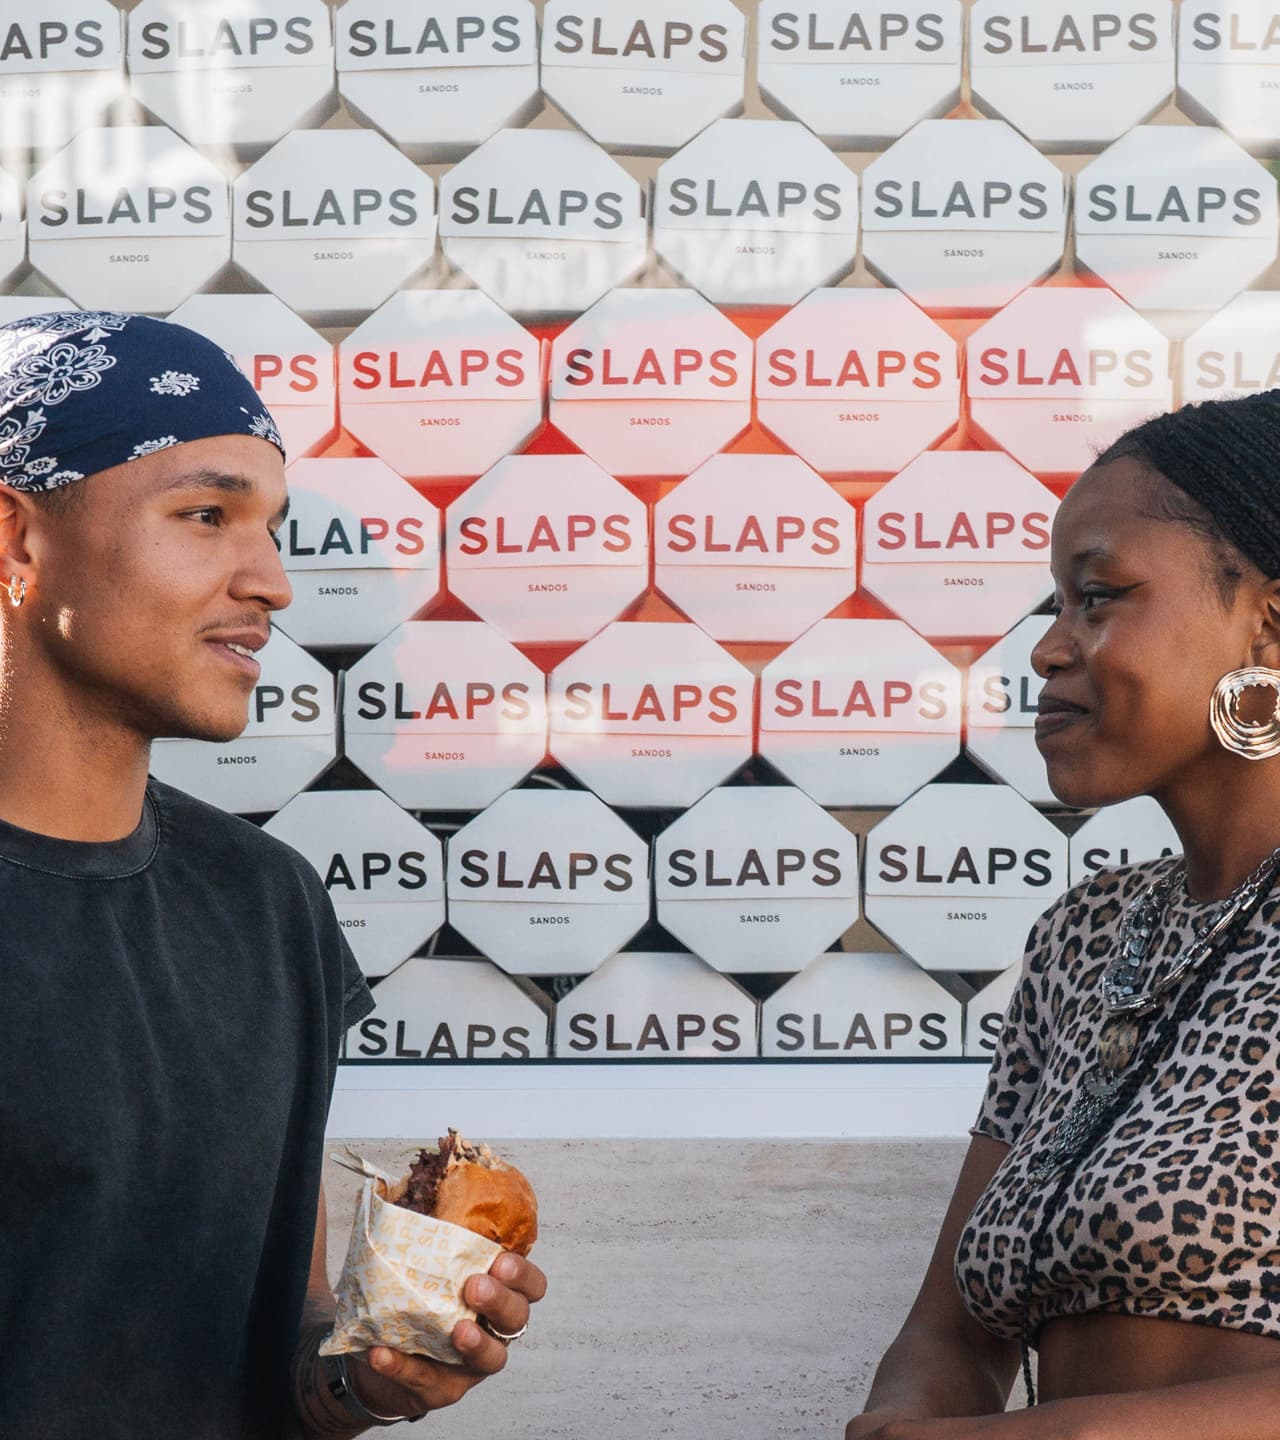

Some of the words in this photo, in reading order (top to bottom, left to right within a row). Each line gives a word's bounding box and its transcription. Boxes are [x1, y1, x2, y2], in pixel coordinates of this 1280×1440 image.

[349, 15, 520, 57] SLAPS
[555, 15, 727, 62] SLAPS
[771, 13, 944, 52] SLAPS
[984, 13, 1157, 54] SLAPS
[419, 84, 458, 93] SANDOS
[622, 86, 662, 95] SANDOS
[1053, 82, 1093, 90] SANDOS
[40, 186, 212, 226] SLAPS
[246, 189, 417, 228] SLAPS
[451, 187, 622, 229] SLAPS
[669, 178, 841, 221] SLAPS
[874, 180, 1047, 220] SLAPS
[1089, 185, 1260, 225] SLAPS
[110, 254, 149, 262] SANDOS
[314, 252, 353, 260] SANDOS
[944, 249, 984, 257] SANDOS
[1158, 252, 1198, 260] SANDOS
[353, 349, 524, 389] SLAPS
[566, 349, 737, 387] SLAPS
[768, 349, 941, 389] SLAPS
[980, 348, 1153, 388] SLAPS
[420, 418, 460, 426] SANDOS
[1053, 414, 1092, 422] SANDOS
[273, 516, 424, 556] LAPS
[460, 515, 631, 555] SLAPS
[668, 514, 840, 555] SLAPS
[878, 512, 1050, 550] SLAPS
[318, 587, 358, 595] SANDOS
[528, 584, 568, 592] SANDOS
[944, 578, 984, 586] SANDOS
[358, 682, 529, 720] SLAPS
[565, 682, 737, 723] SLAPS
[775, 679, 947, 720] SLAPS
[217, 756, 256, 765] SANDOS
[425, 752, 464, 760] SANDOS
[632, 749, 671, 757] SANDOS
[840, 748, 879, 756] SANDOS
[325, 851, 427, 891] APS
[460, 850, 632, 892] SLAPS
[668, 849, 841, 887] SLAPS
[879, 845, 1052, 886] SLAPS
[339, 919, 366, 928] NDOS
[530, 916, 570, 925] SANDOS
[740, 915, 780, 923] SANDOS
[358, 1018, 530, 1058] SLAPS
[569, 1013, 740, 1052] SLAPS
[776, 1013, 947, 1051] SLAPS
